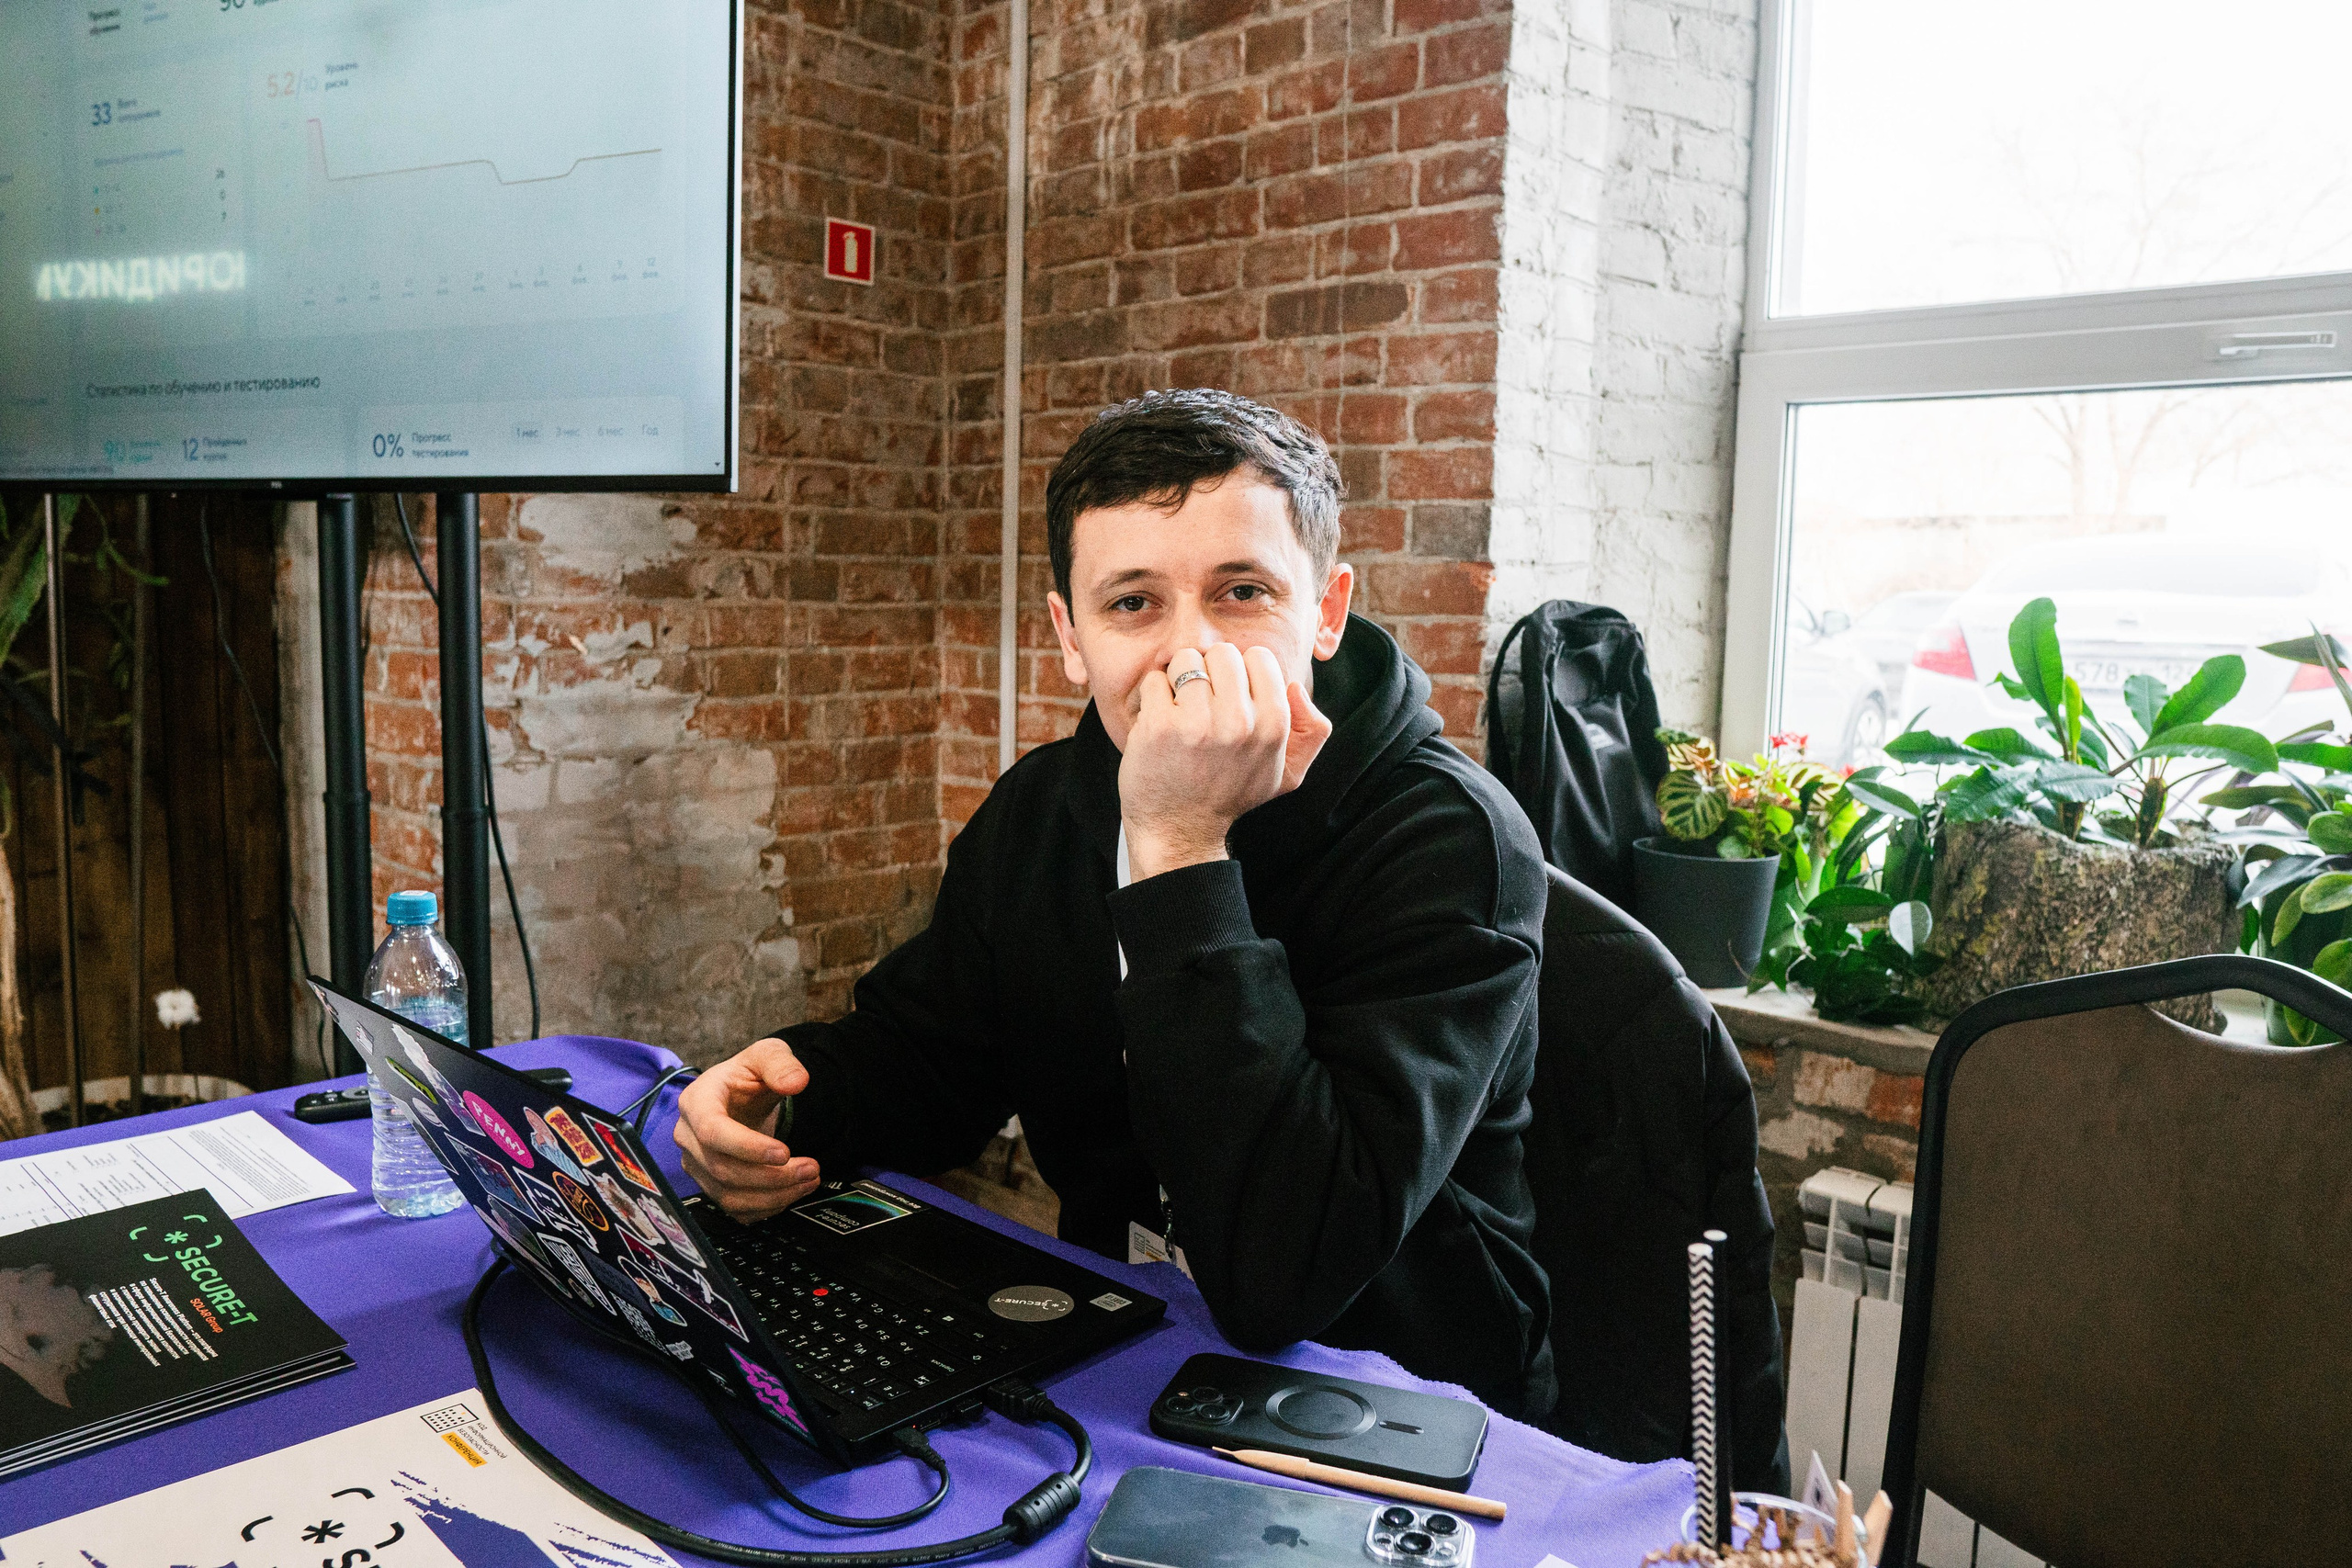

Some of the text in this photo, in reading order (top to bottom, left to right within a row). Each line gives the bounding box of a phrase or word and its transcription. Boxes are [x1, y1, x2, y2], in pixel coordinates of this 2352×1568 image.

[92, 102, 112, 126] 33
[164, 379, 220, 398] обучению
[233, 376, 321, 394] тестированию
[183, 437, 198, 461] 12
[372, 433, 404, 458] 0%
[411, 432, 451, 445] Прогресс
[175, 1247, 258, 1325] SECURE-T
[189, 1297, 223, 1334] SOLAR Group
[994, 1297, 1047, 1309] SECURE-T
[447, 1435, 482, 1465] КОНФЕРЕНЦИЯ
[458, 1428, 490, 1456] БЕЗОПАСНОСТИ
[467, 1426, 508, 1460] ИНФОРМАЦИОННОЙ
